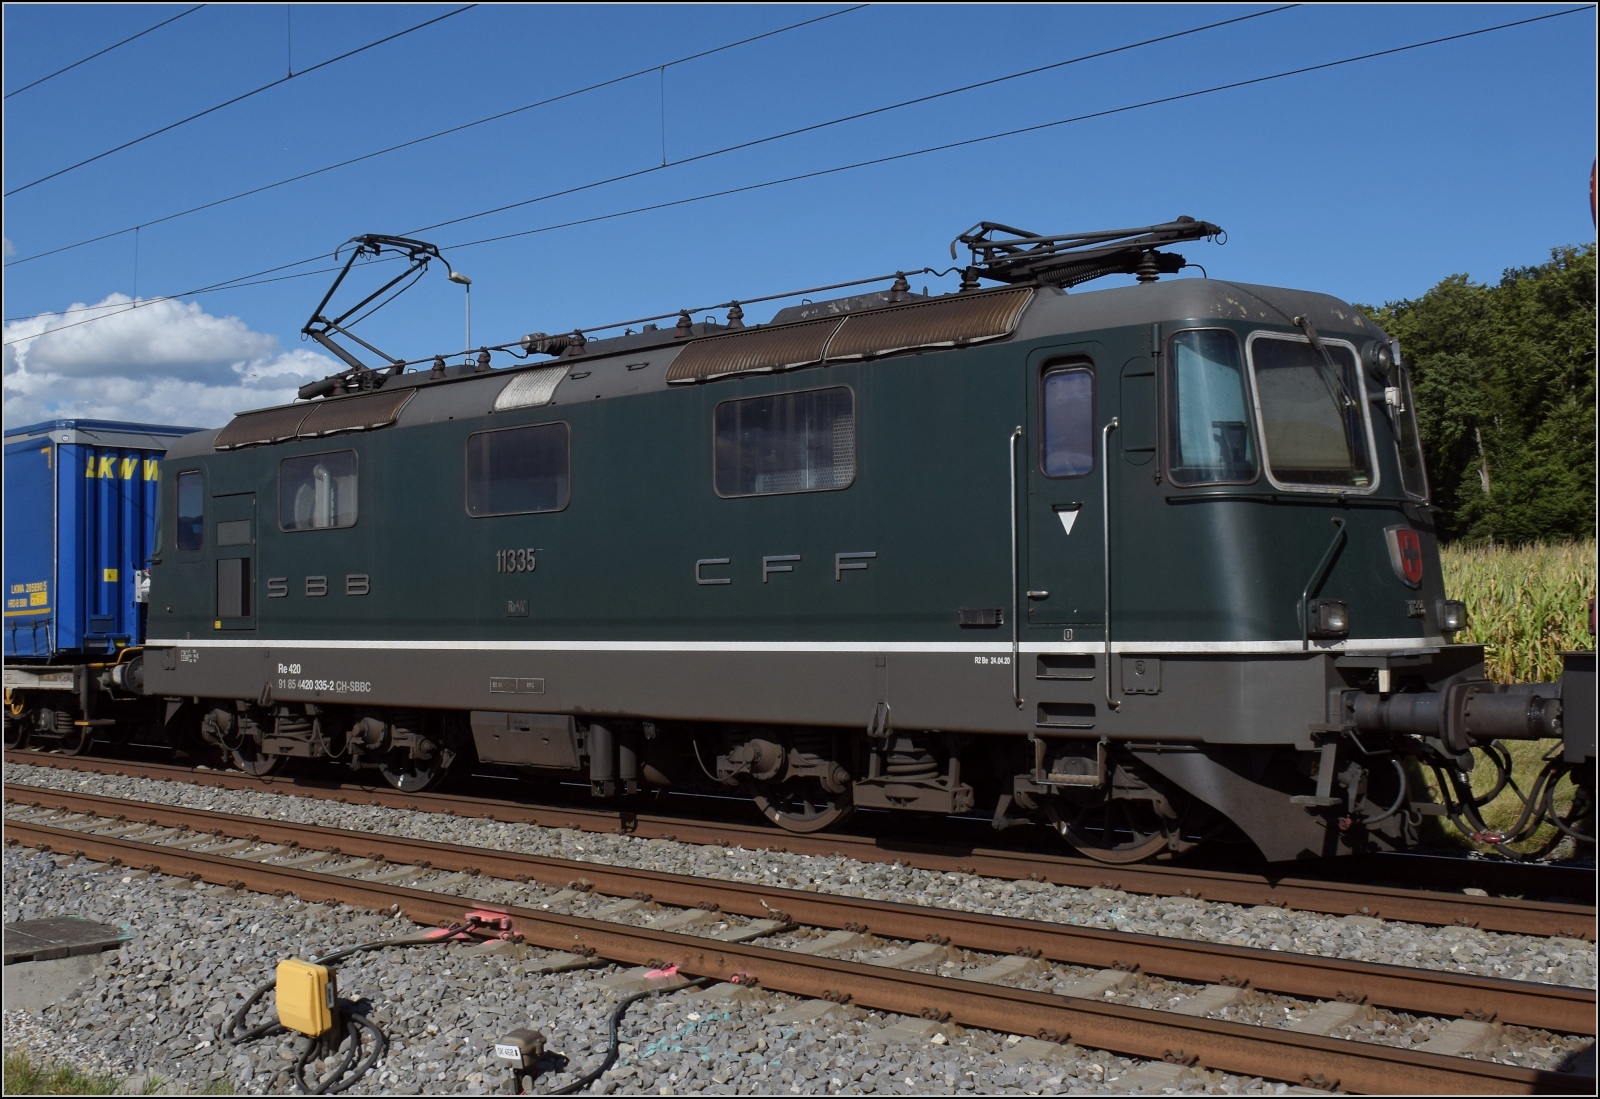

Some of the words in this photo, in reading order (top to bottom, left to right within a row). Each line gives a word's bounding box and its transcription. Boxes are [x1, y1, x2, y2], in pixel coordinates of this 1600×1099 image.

[86, 456, 138, 480] LKW
[496, 548, 537, 573] 11335
[695, 551, 877, 585] CFF
[267, 573, 370, 598] SBB
[278, 663, 288, 674] Re
[289, 663, 301, 674] 420
[974, 656, 981, 664] R2
[279, 679, 286, 689] 91
[288, 679, 296, 690] 85
[297, 679, 314, 690] 4420
[315, 680, 334, 691] 335-2
[336, 681, 371, 693] CH-SBBC
